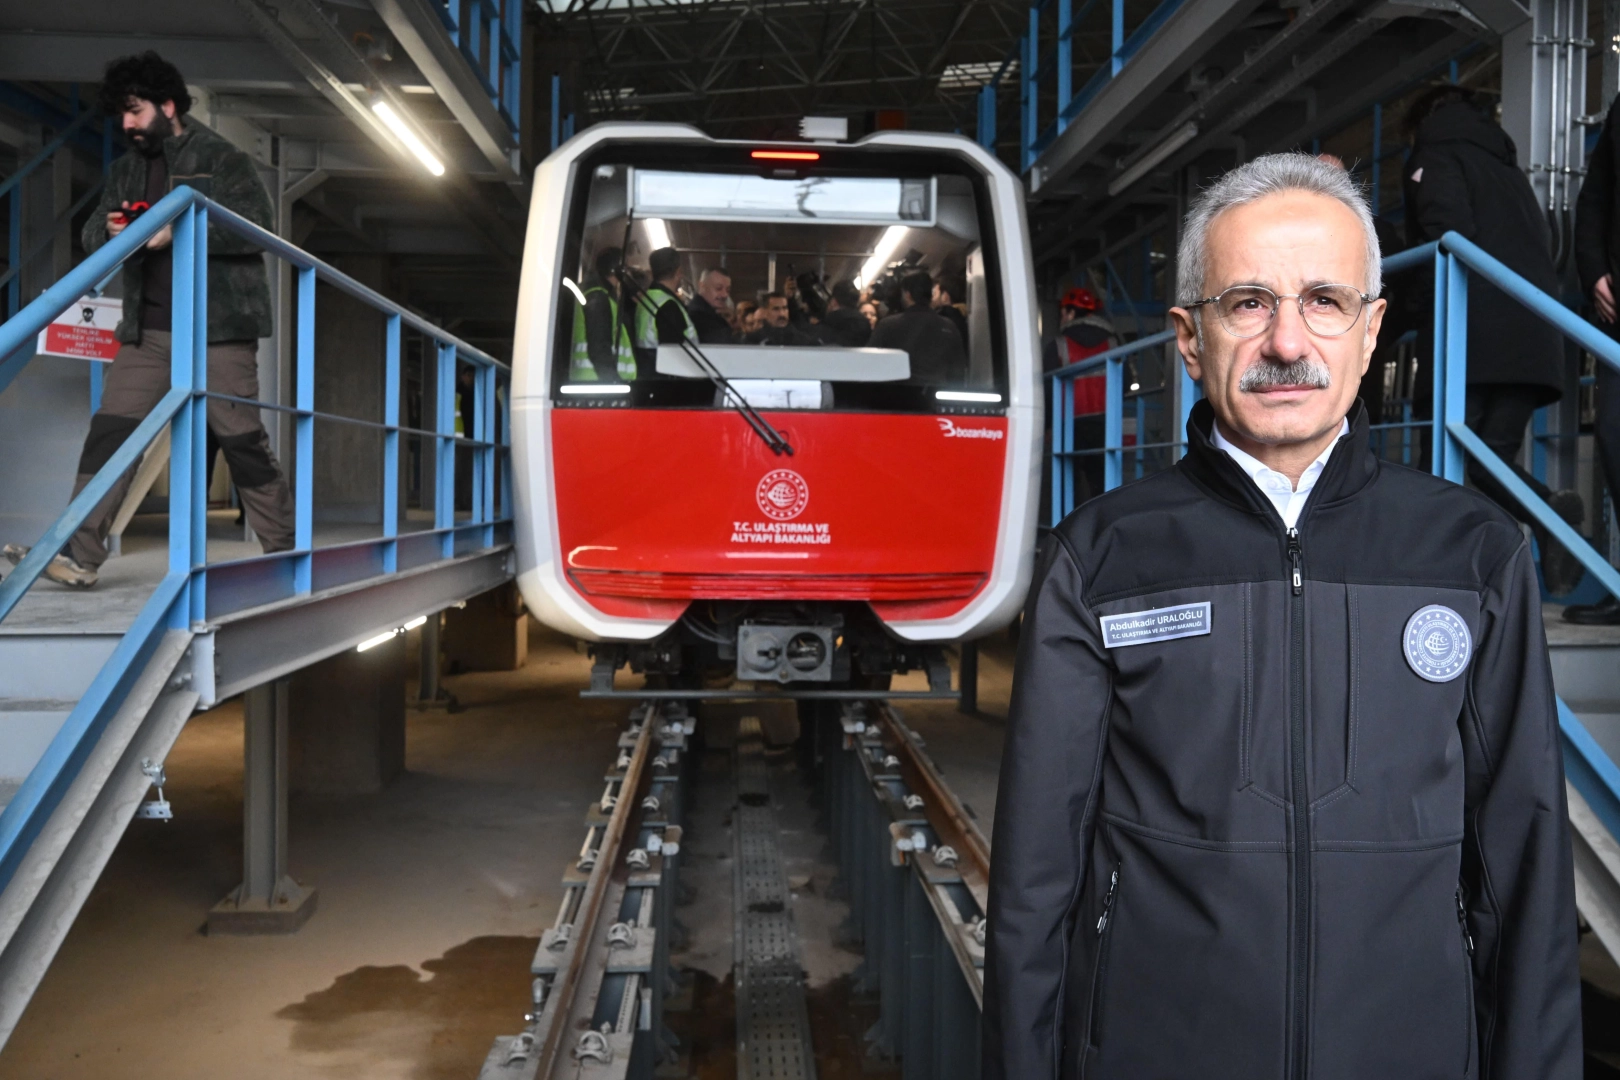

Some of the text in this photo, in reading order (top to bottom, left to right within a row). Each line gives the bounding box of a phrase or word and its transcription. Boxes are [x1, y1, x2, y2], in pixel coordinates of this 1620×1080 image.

[733, 521, 830, 534] T.C. ULAŞTIRMA VE
[731, 532, 831, 544] ALTYAPI BAKANLIĞI
[1109, 610, 1203, 632] Abdulkadir URALOĞLU
[1121, 629, 1152, 639] ULAŞTIRMA
[1159, 625, 1177, 633] ALTYAPI
[1177, 621, 1203, 630] BAKANLIĞI
